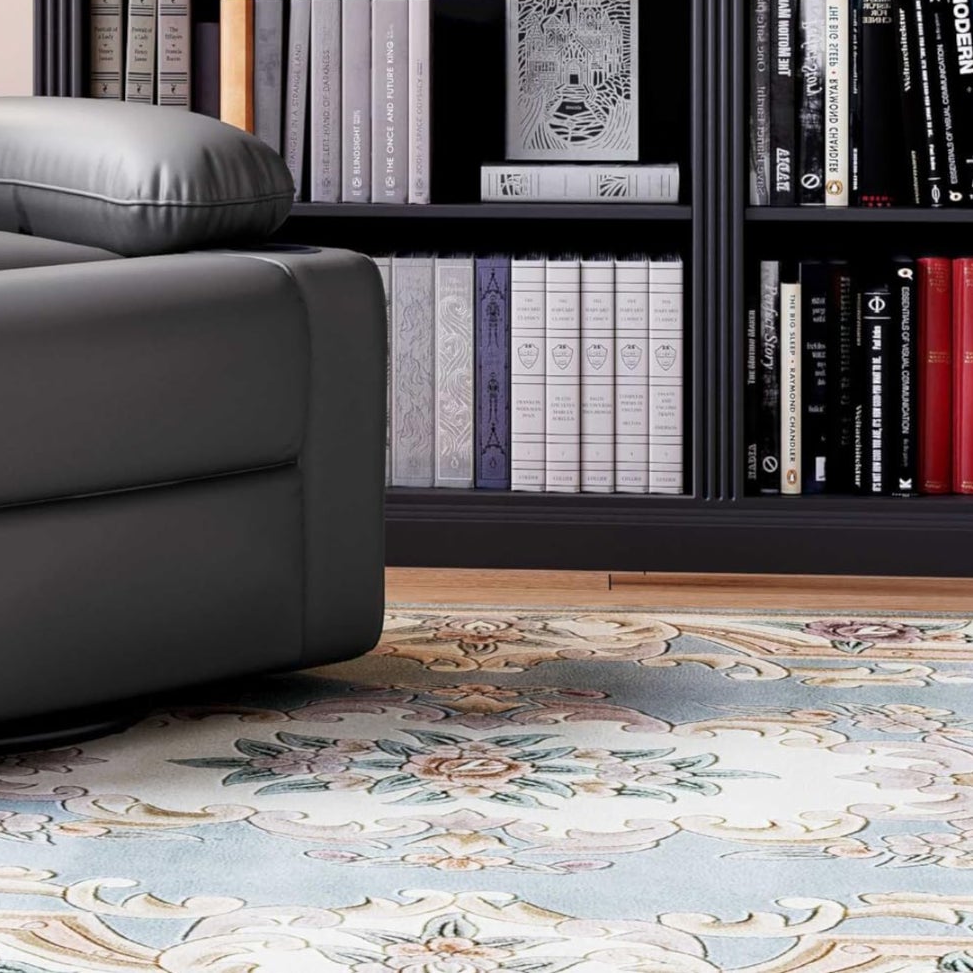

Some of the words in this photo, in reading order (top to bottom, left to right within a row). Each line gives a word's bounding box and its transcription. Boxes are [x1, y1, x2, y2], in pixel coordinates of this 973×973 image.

[386, 40, 394, 64] KING
[898, 7, 911, 92] Weltarchitektur
[386, 67, 394, 99] FUTURE
[386, 102, 394, 122] AND
[353, 125, 361, 175] BLINDSIGHT
[386, 125, 394, 153] ONCE
[386, 157, 394, 173] THE
[762, 285, 778, 330] Perfect
[901, 286, 910, 331] ESSENTIALS
[760, 334, 778, 370] Story
[901, 332, 910, 343] OF
[901, 344, 910, 369] VISUAL
[901, 370, 910, 434] COMMUNICATION
